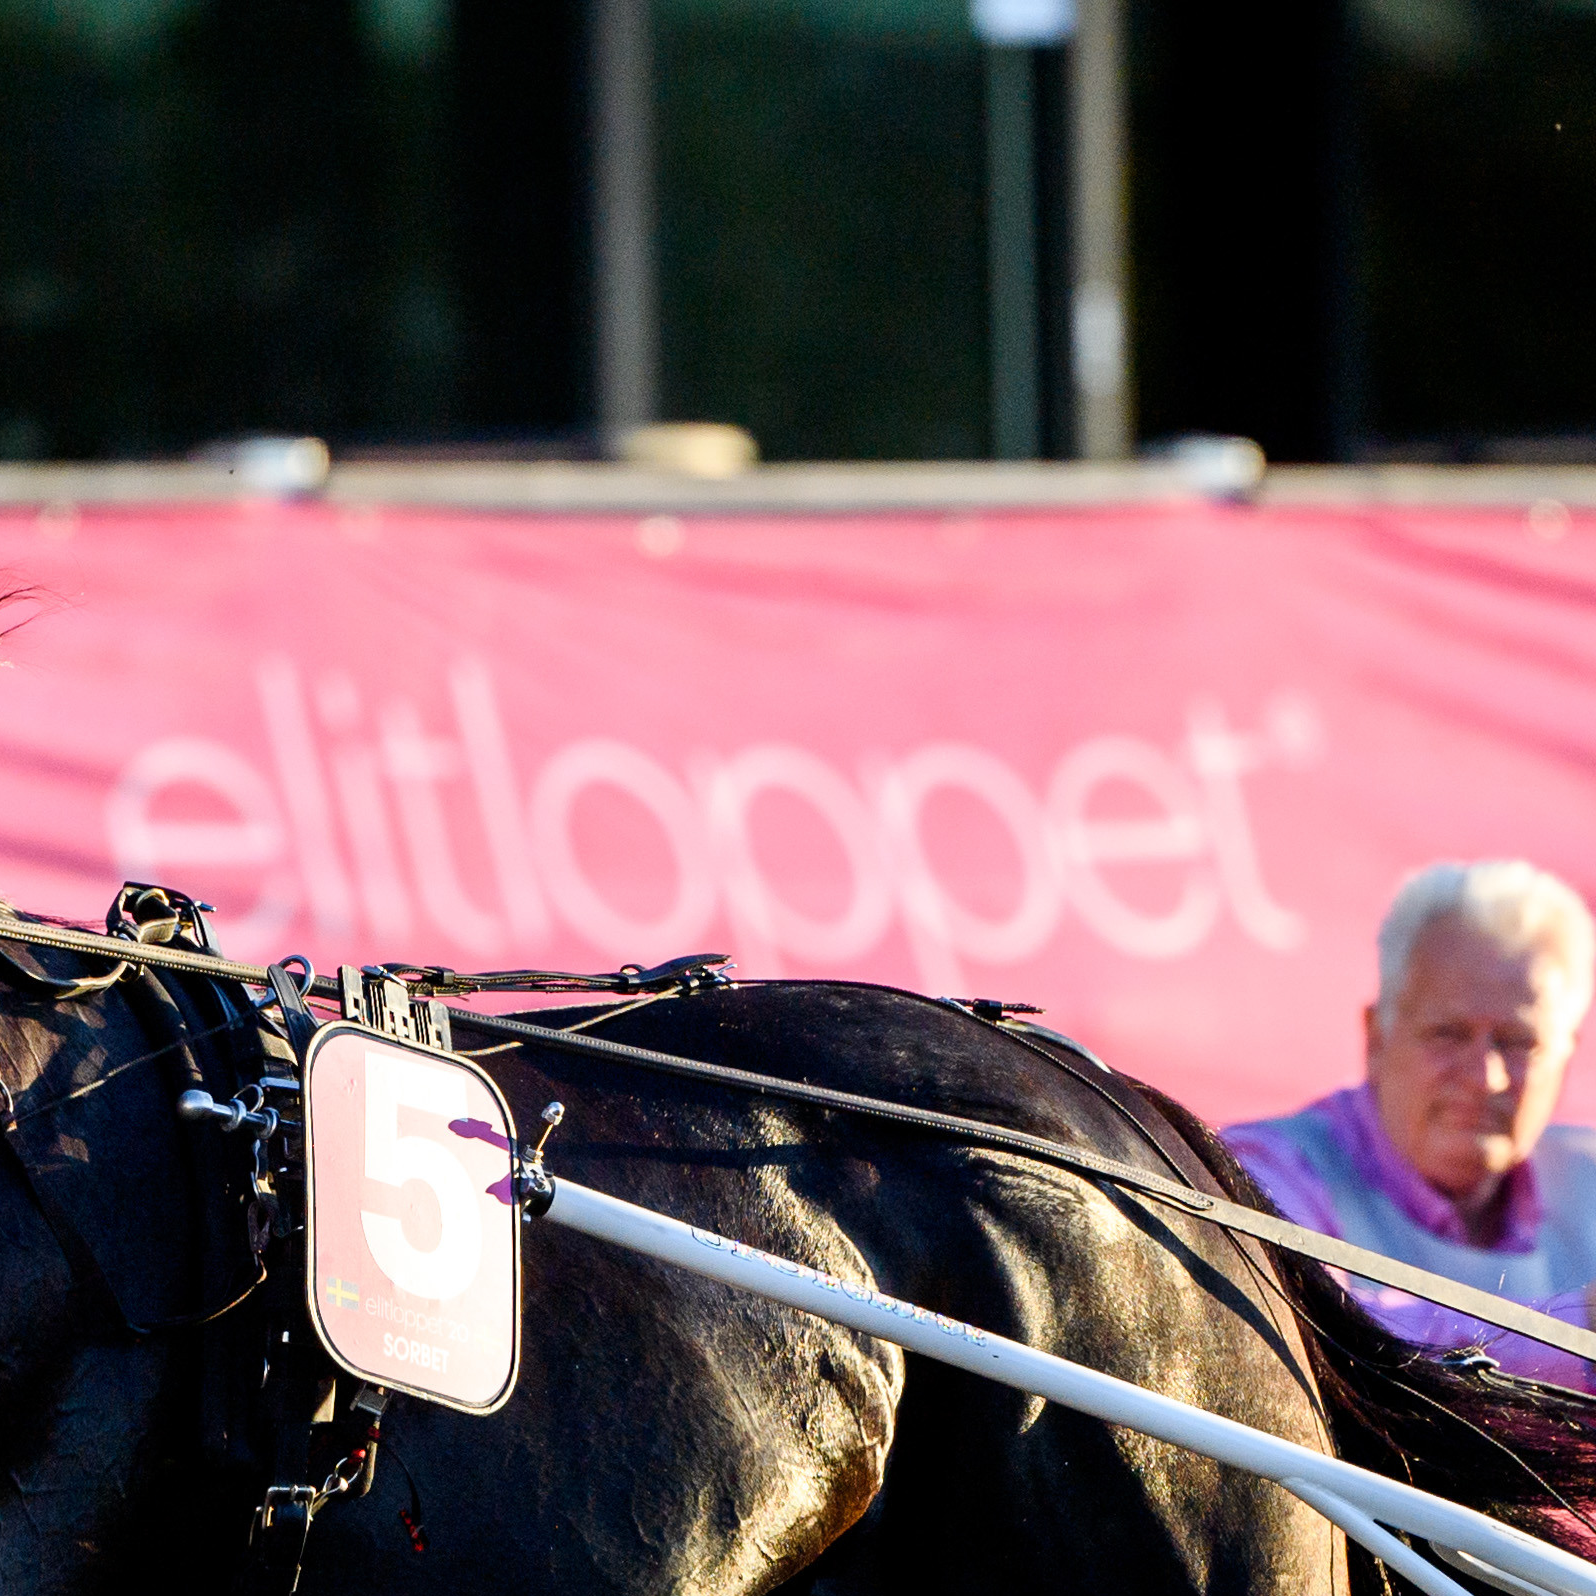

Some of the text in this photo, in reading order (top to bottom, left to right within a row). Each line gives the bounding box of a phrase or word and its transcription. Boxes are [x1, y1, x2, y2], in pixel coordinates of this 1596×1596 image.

[104, 650, 1306, 995] elitloppet
[360, 1050, 482, 1301] 5
[382, 1331, 450, 1375] SORBET
